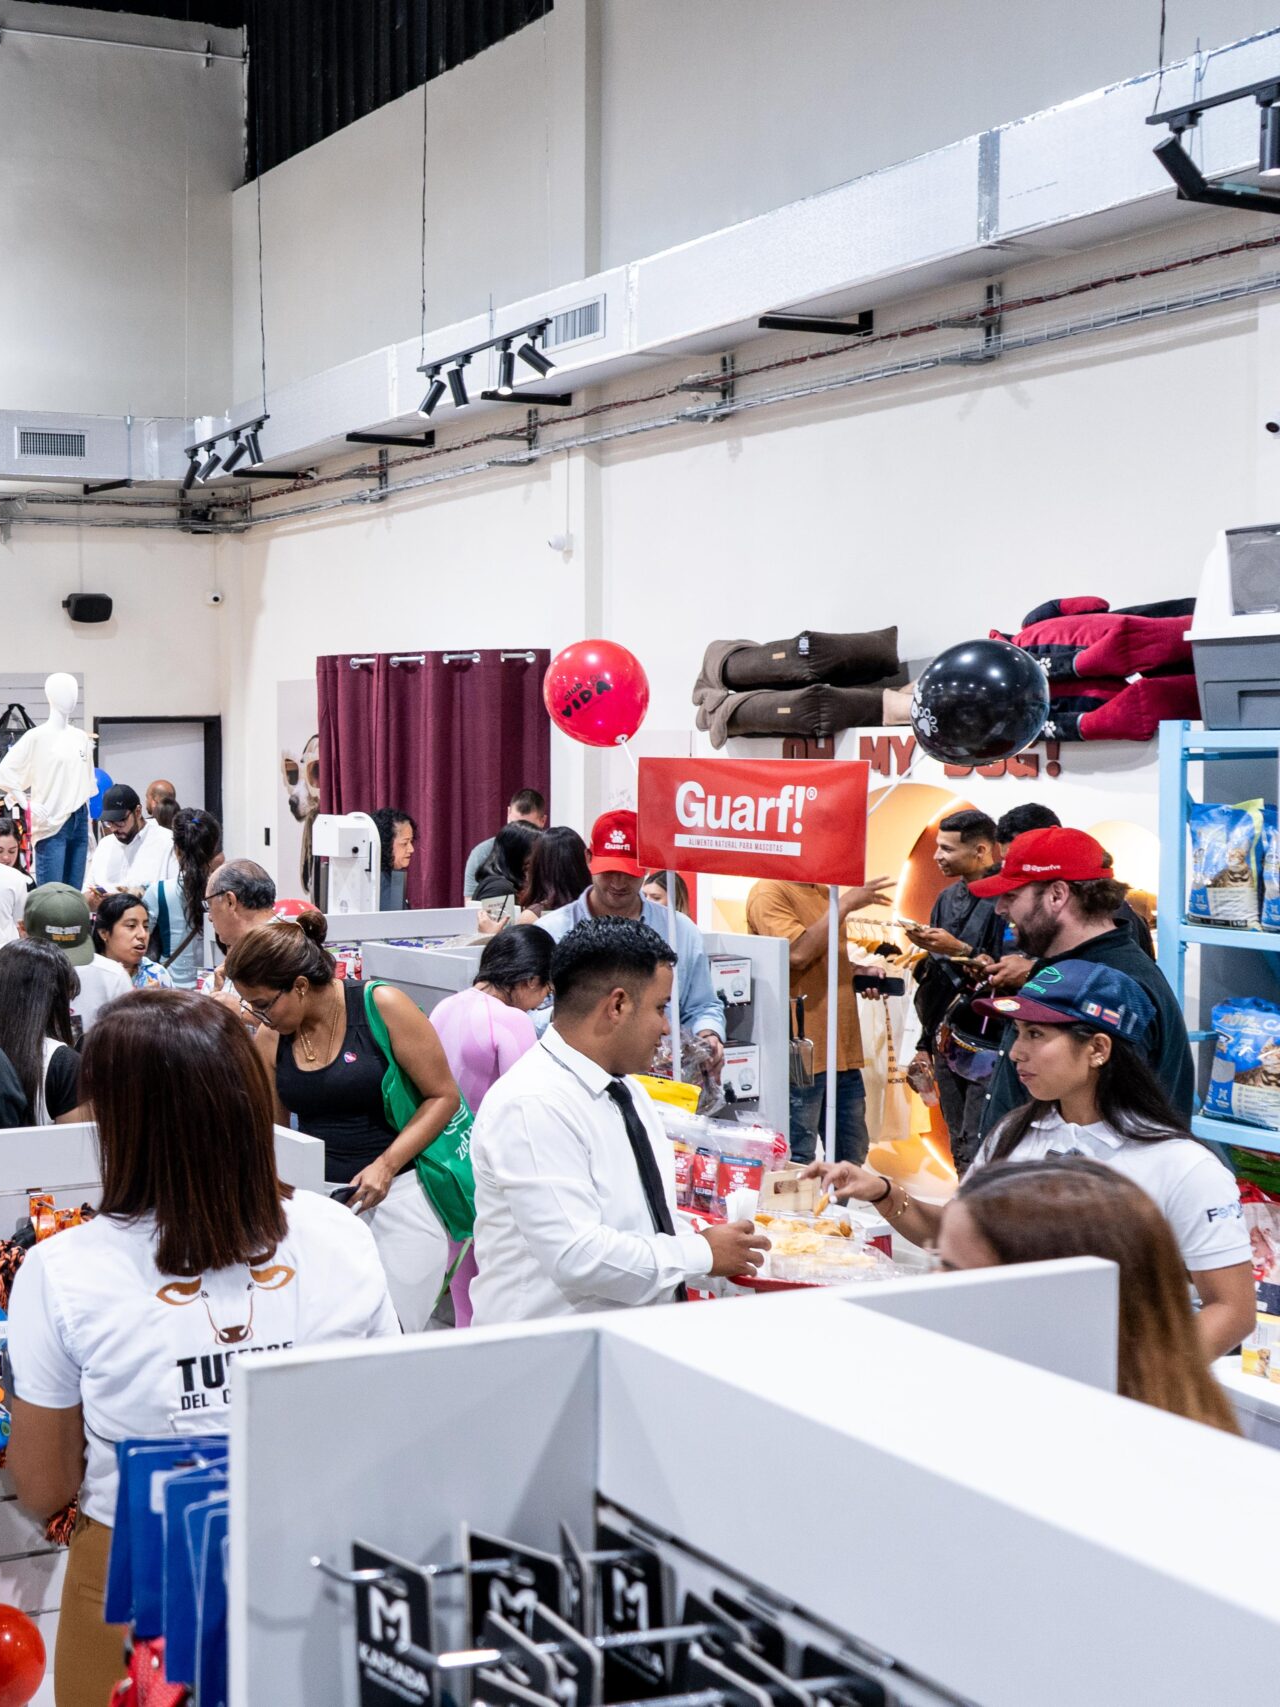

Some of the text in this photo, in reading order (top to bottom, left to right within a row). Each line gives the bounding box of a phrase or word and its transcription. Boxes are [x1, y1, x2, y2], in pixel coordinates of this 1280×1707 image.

[859, 735, 917, 777] MY
[675, 780, 806, 835] Guarf!
[181, 1393, 210, 1411] DEL
